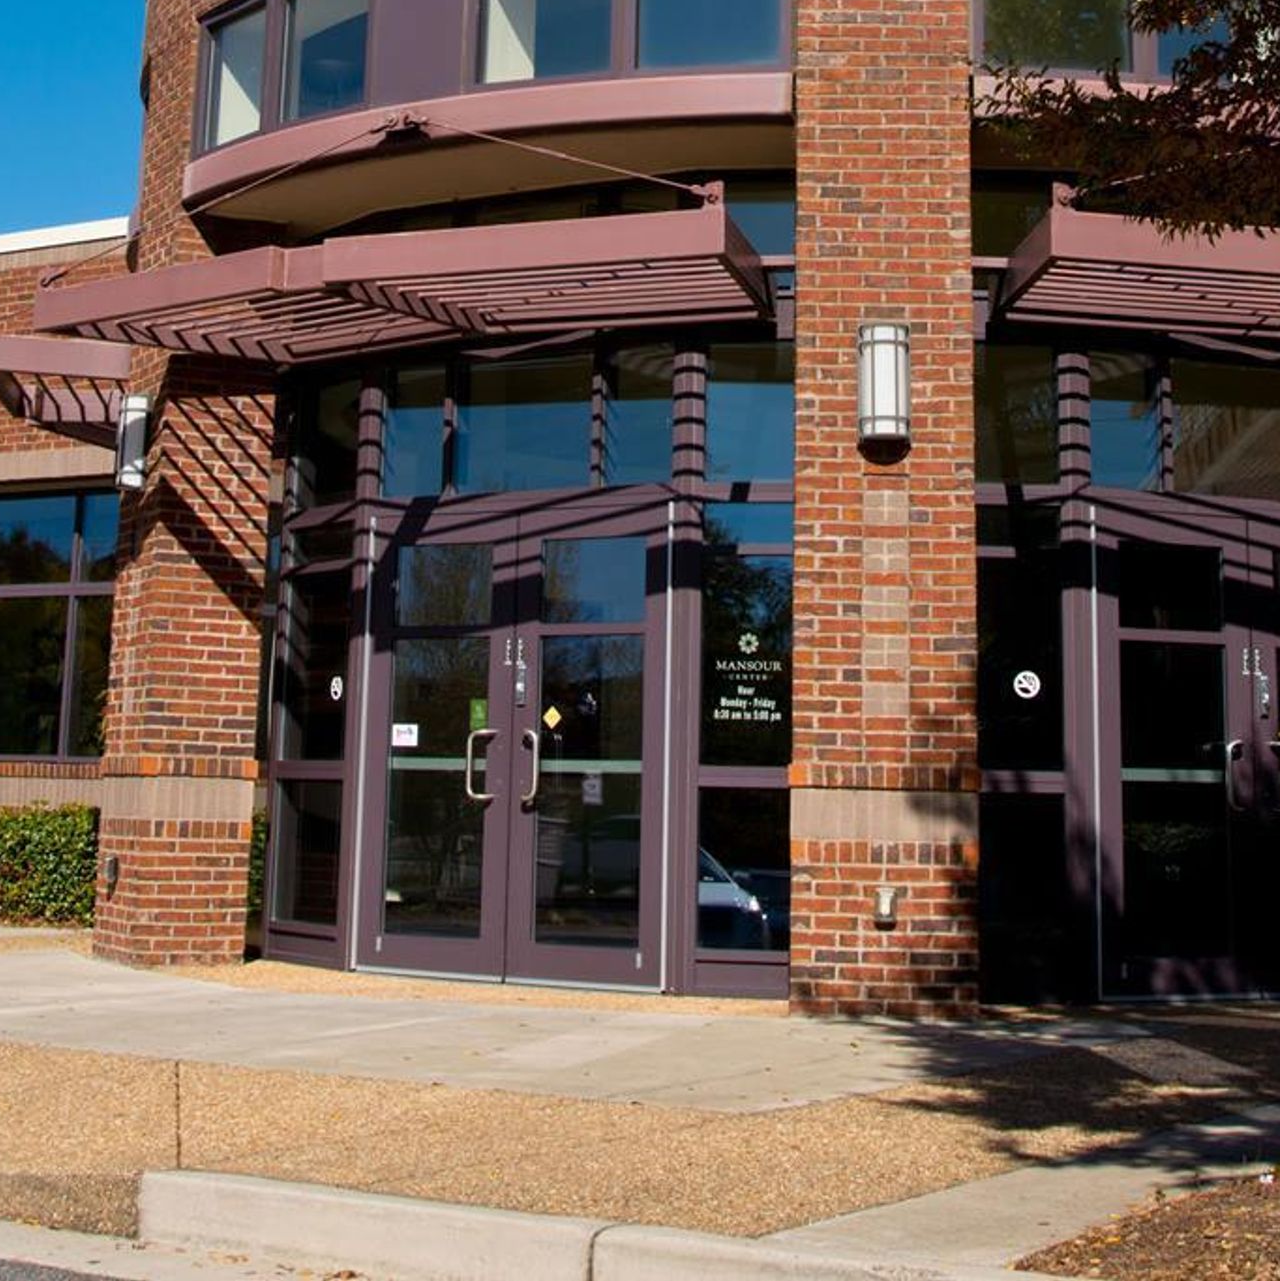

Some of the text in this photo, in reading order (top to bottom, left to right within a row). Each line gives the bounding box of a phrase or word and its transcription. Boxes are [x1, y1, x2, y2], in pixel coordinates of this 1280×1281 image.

[715, 660, 782, 671] MANSOUR
[728, 673, 768, 681] CENTER
[720, 697, 747, 709] Monday
[753, 698, 776, 710] Friday
[731, 711, 742, 720] am
[743, 711, 751, 720] to
[770, 712, 782, 722] pm
